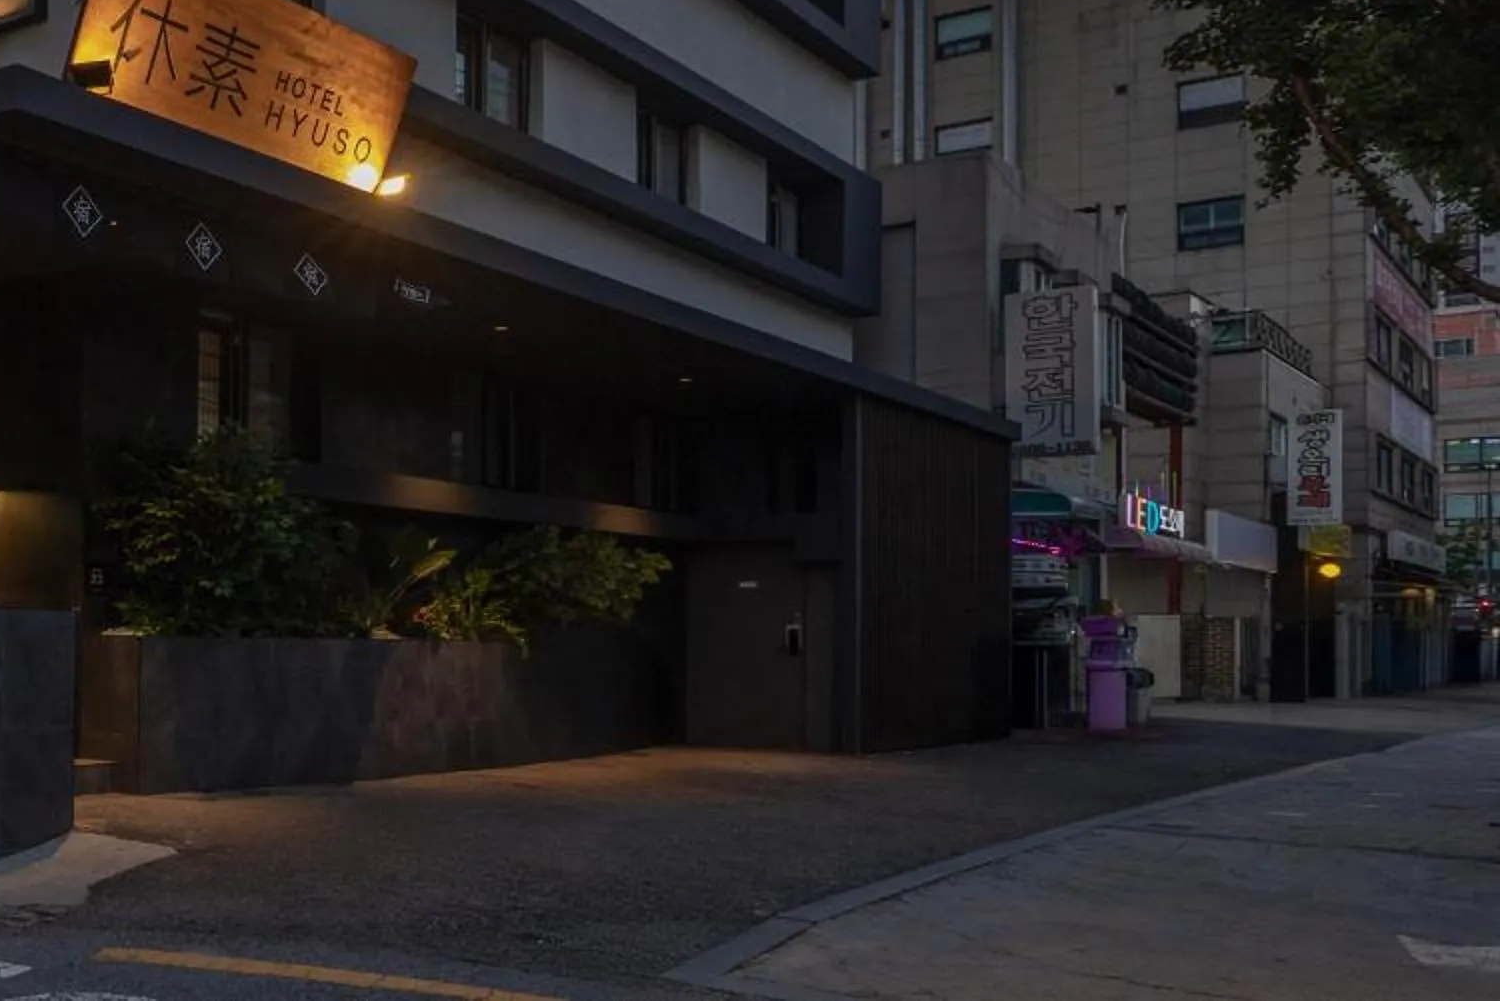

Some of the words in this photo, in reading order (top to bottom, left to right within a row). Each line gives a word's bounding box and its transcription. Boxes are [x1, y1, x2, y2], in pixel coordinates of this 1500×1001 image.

[275, 71, 343, 117] HOTEL
[265, 101, 372, 164] HYUSO
[1022, 293, 1078, 438] 한국전기
